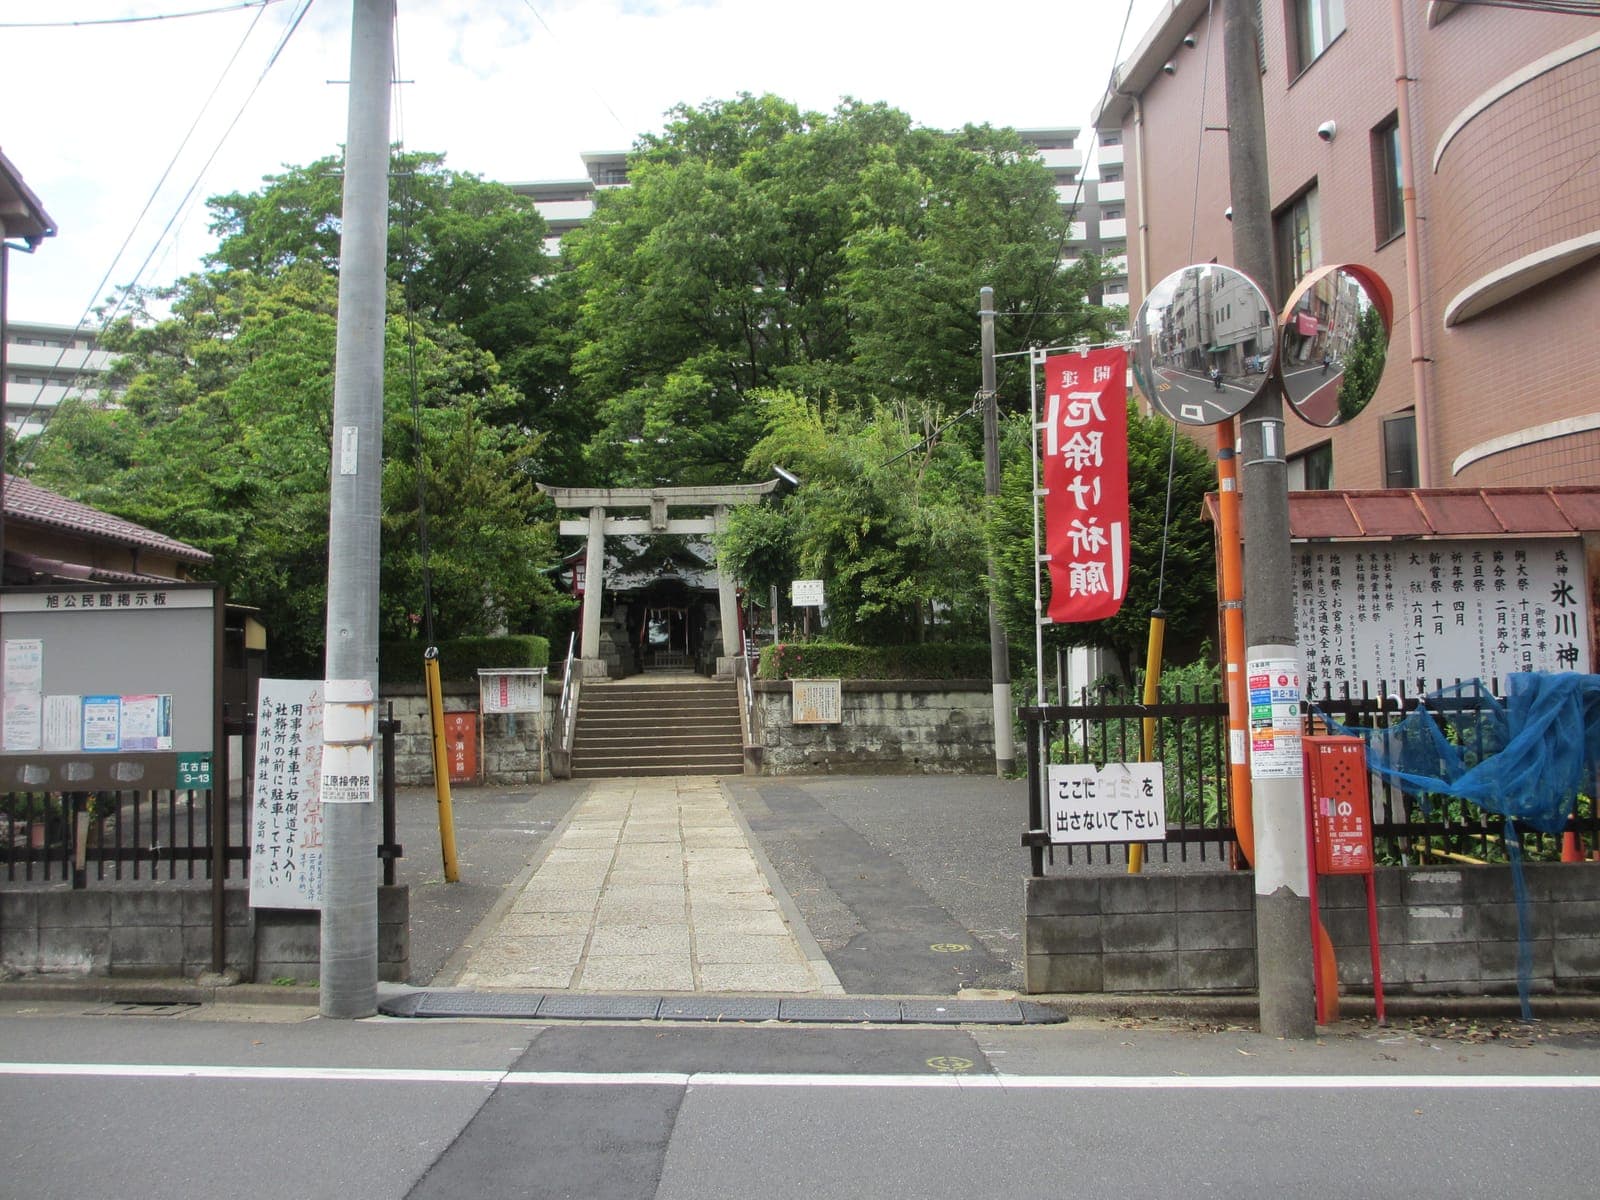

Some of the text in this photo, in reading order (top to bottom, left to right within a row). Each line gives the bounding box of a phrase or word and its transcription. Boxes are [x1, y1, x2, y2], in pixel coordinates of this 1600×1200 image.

[1471, 551, 1486, 592] 元旦祭
[1554, 550, 1568, 577] 氏神
[46, 592, 169, 609] 旭公民館掲示板
[1429, 551, 1444, 635] 新嘗祭 十一月
[1450, 551, 1465, 626] 祈年祭 四月
[1493, 550, 1509, 654] 節分祭 二月節分
[261, 695, 273, 722] 氏神
[179, 762, 209, 772] 江古田
[183, 774, 210, 783] 3-13
[283, 703, 304, 883] 用事参拝車は右側道より入り
[1059, 776, 1154, 800] ここに「ゴミ」を
[1056, 809, 1159, 833] 出さないで下さい
